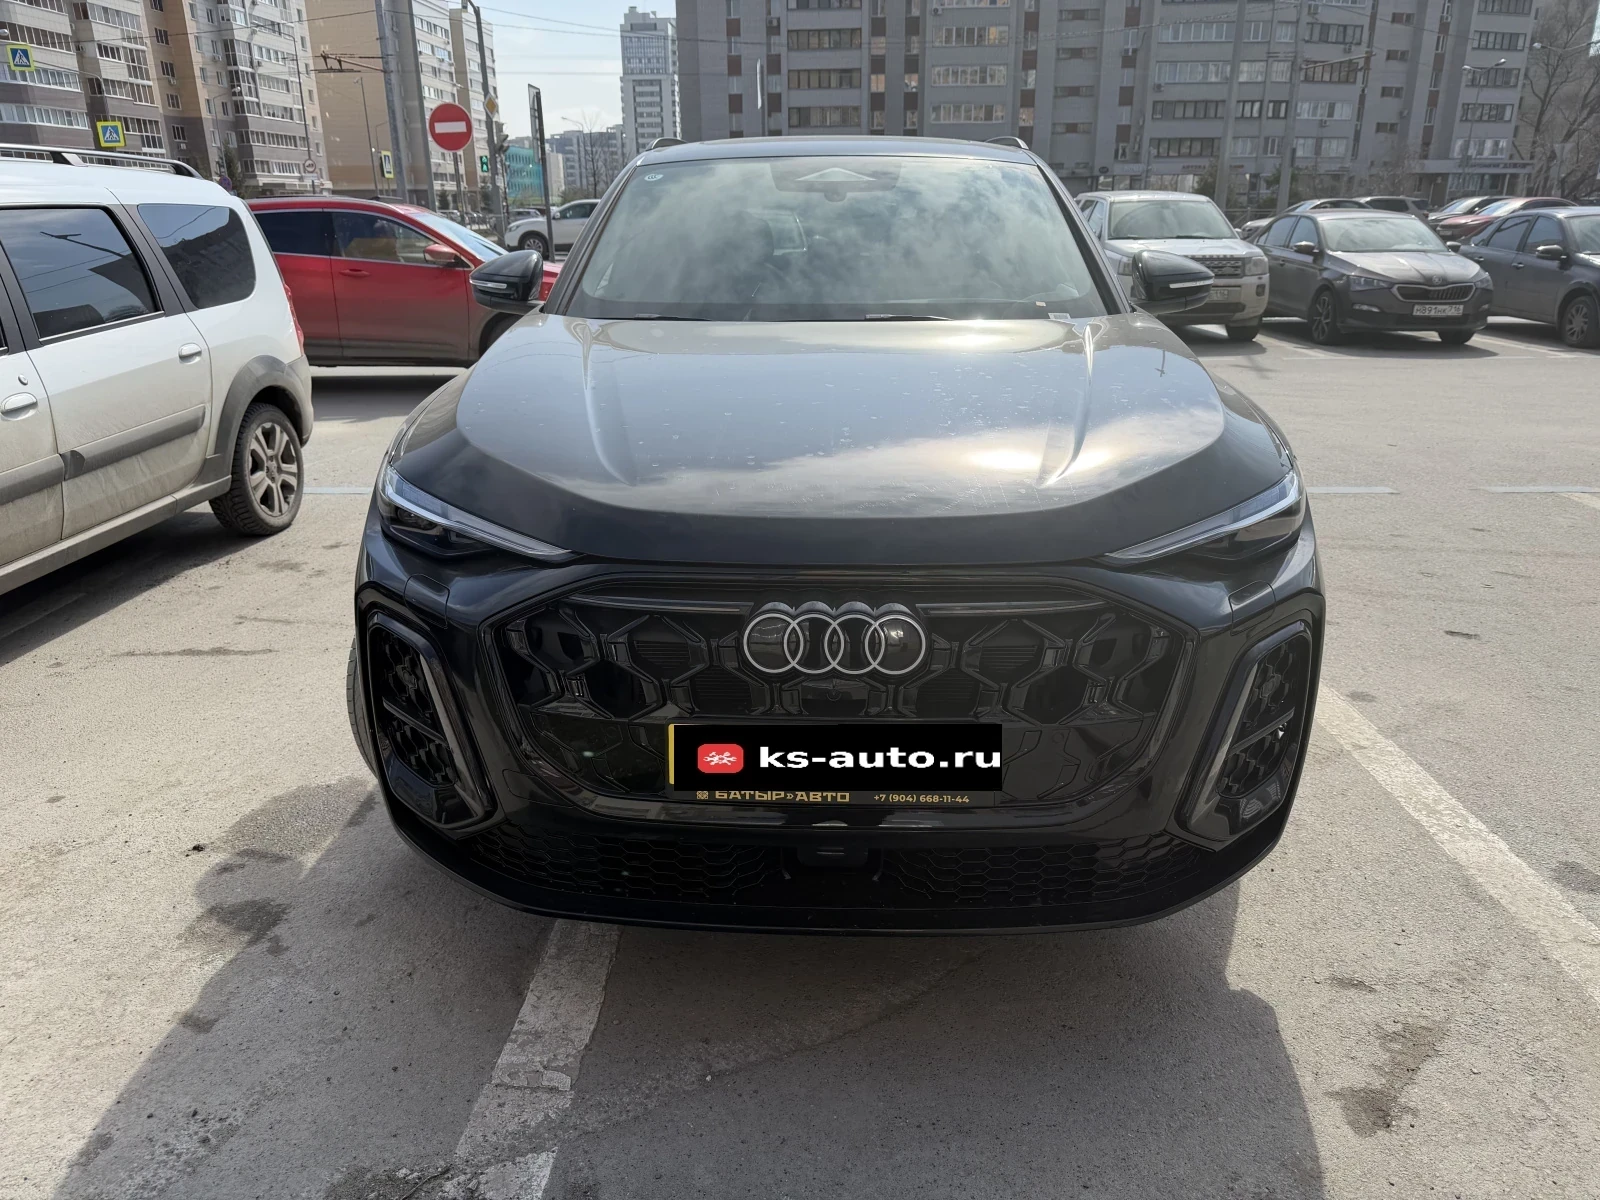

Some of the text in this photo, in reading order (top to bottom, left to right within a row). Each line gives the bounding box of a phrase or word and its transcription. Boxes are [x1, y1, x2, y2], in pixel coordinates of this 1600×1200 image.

[873, 794, 886, 802] +7
[889, 793, 917, 803] (904)
[919, 794, 970, 803] 668-11-44
